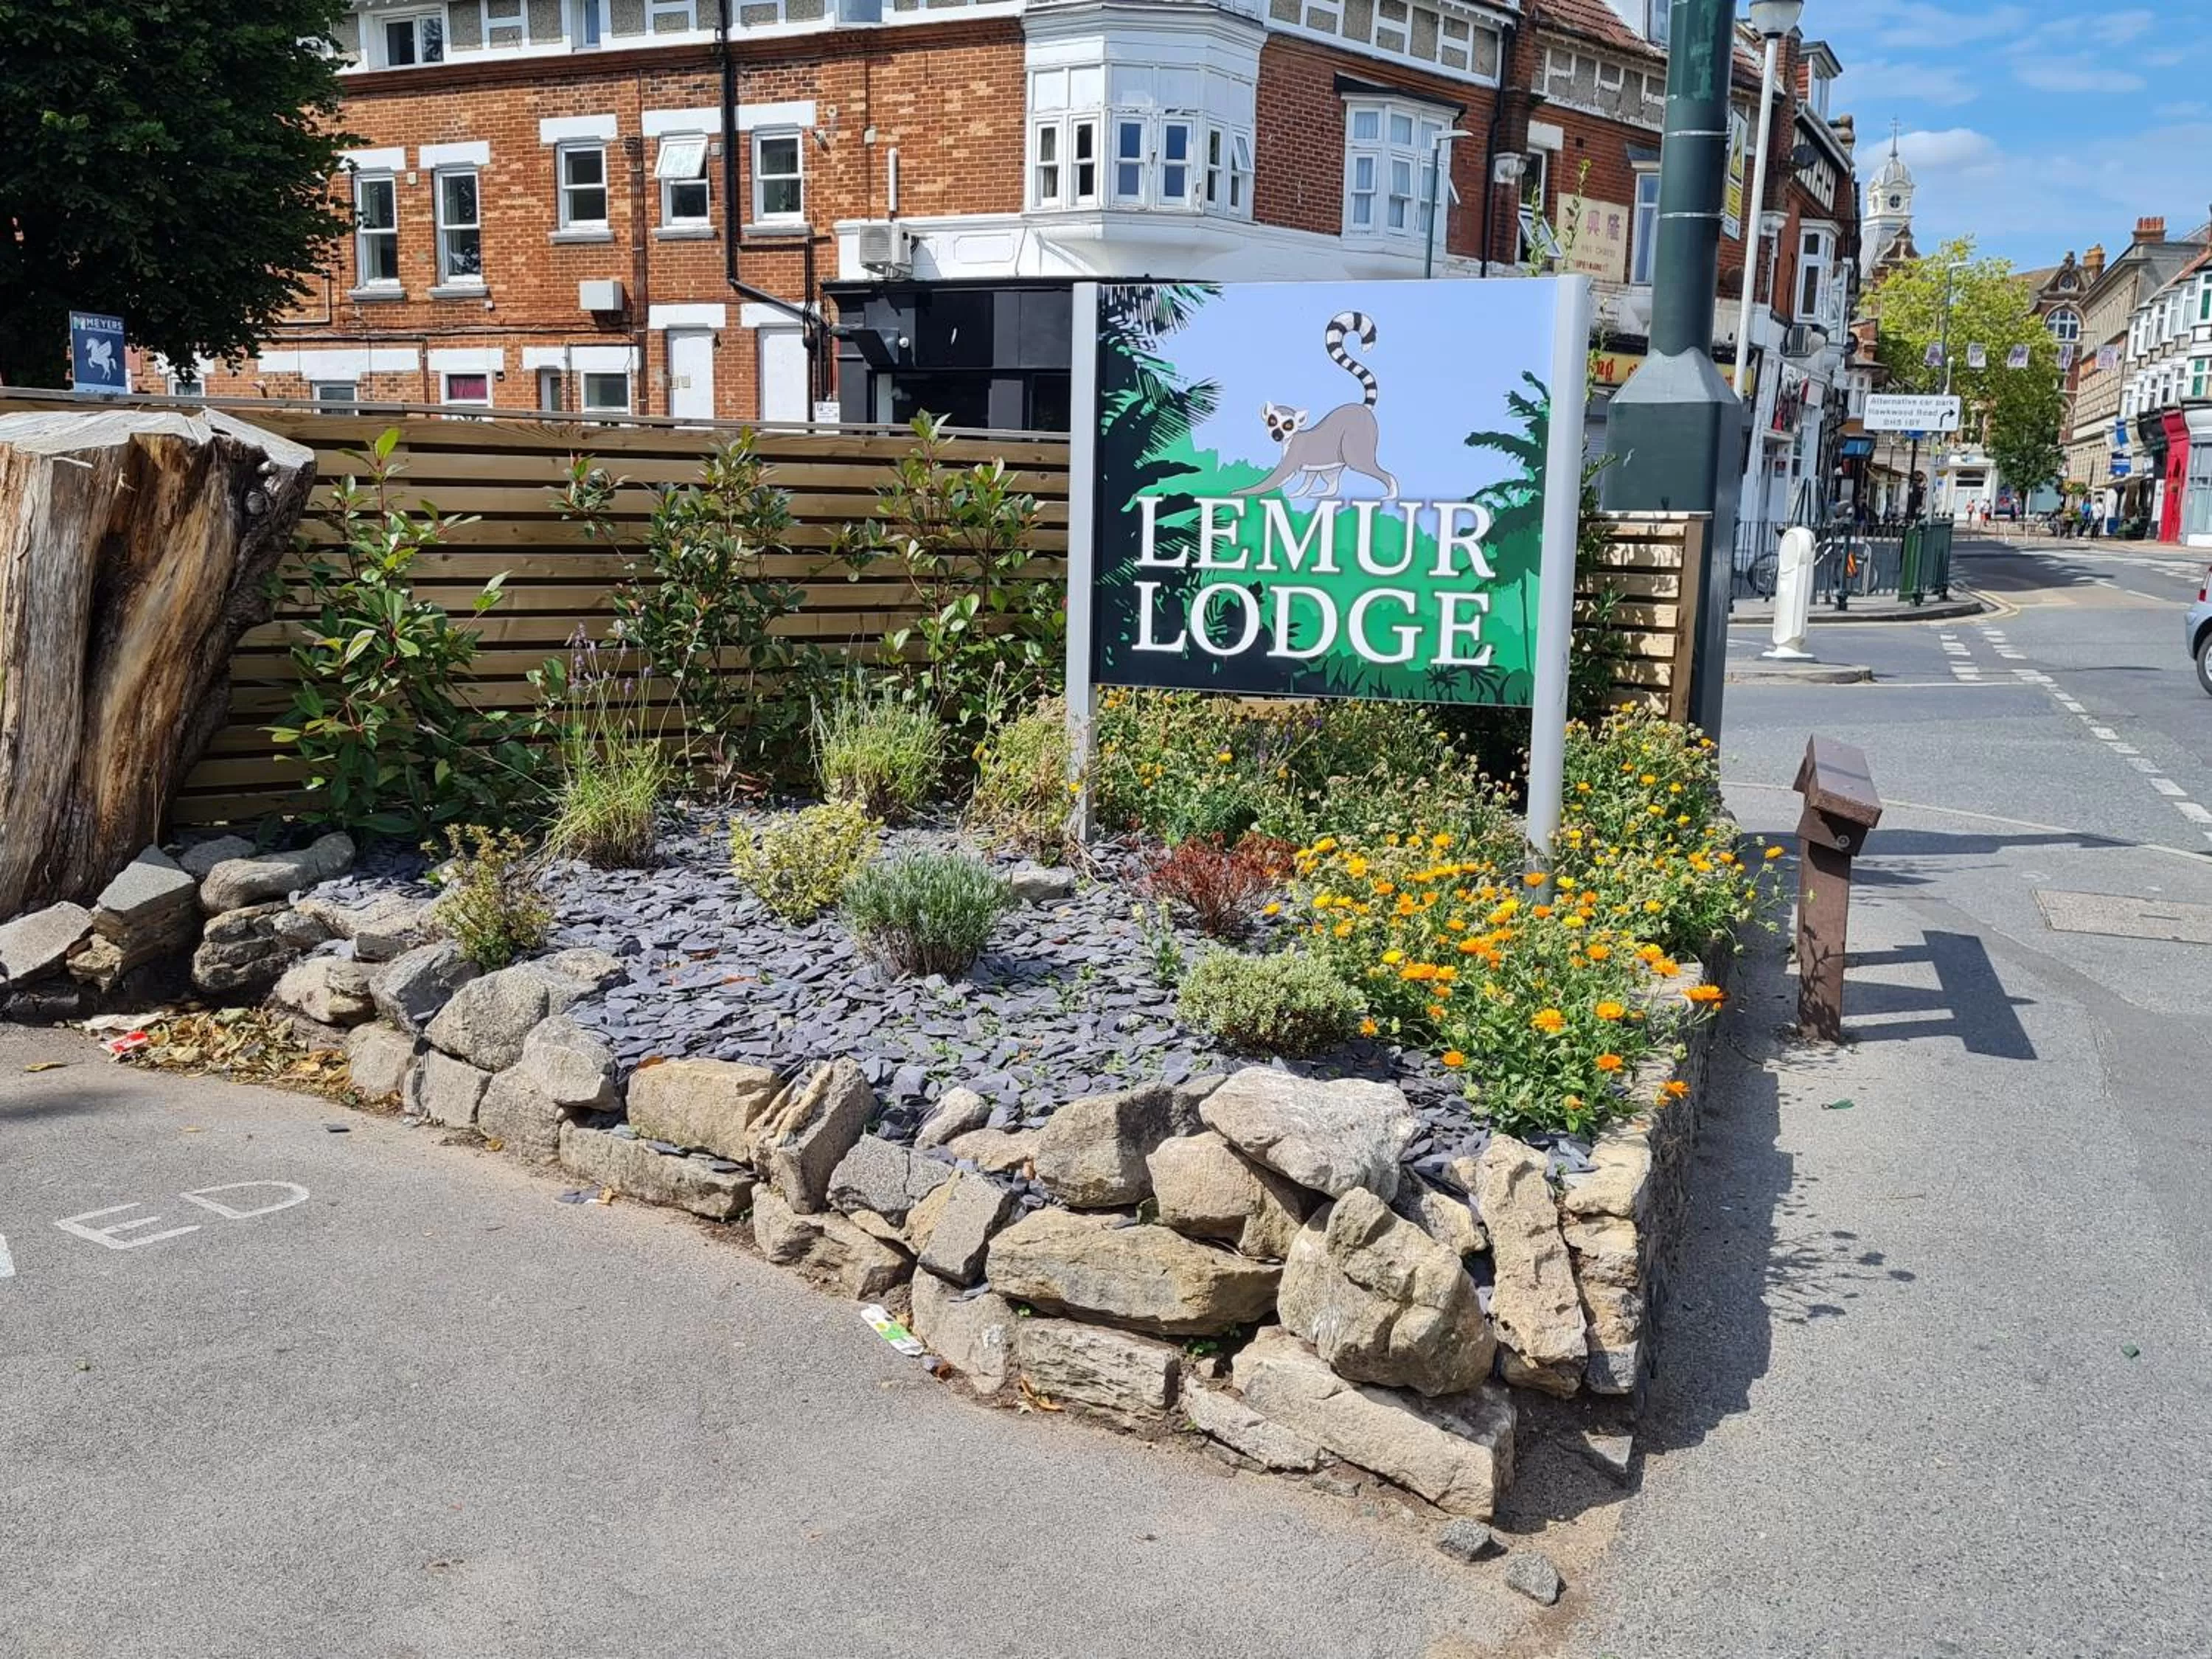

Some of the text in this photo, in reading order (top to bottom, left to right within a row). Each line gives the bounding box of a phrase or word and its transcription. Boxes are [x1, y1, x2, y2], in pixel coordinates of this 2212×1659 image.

[86, 318, 123, 331] MEYERS
[1870, 397, 1917, 406] Alternative
[1935, 399, 1955, 407] park
[1868, 408, 1913, 416] Hawkwood
[1133, 495, 1496, 579] LEMUR
[1132, 580, 1494, 666] LODGE
